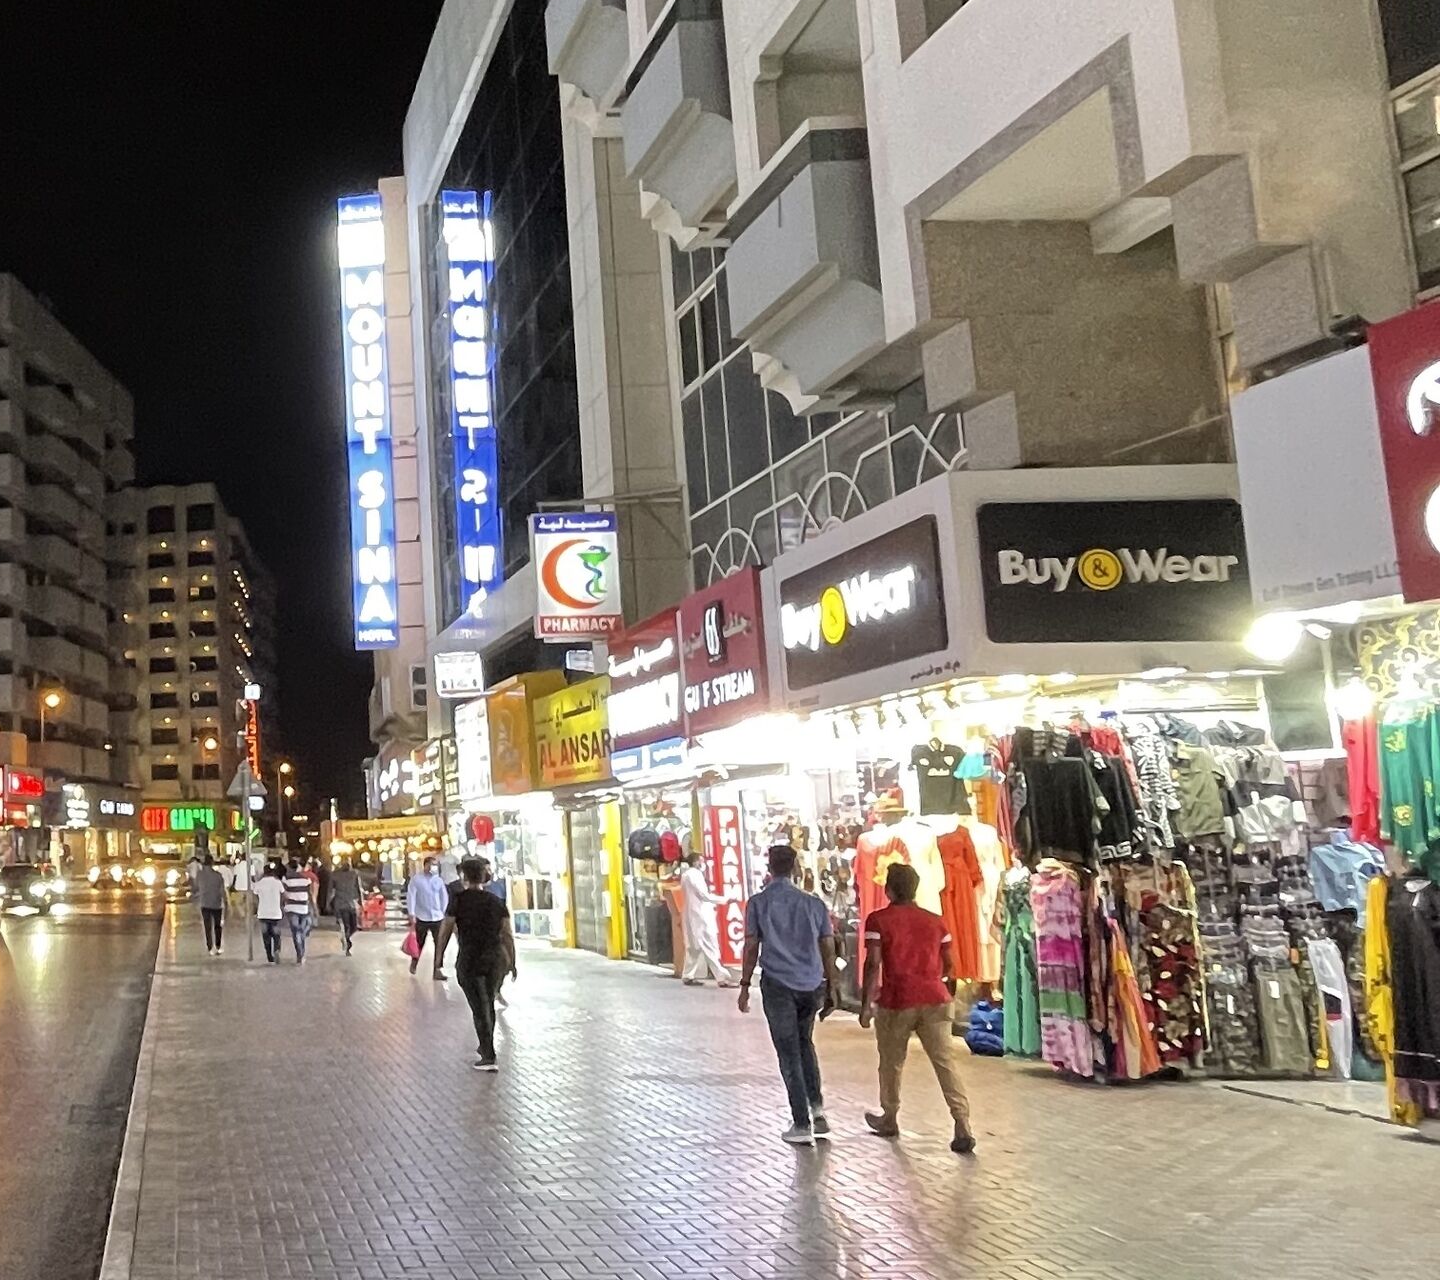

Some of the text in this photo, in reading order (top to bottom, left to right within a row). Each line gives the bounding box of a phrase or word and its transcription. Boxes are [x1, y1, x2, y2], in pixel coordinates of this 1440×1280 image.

[344, 270, 386, 454] MOUNT
[357, 470, 396, 623] SINA
[538, 517, 610, 532] صيدلية
[997, 549, 1079, 593] Buy
[1115, 547, 1239, 584] Wear
[839, 564, 916, 627] Wear
[543, 617, 616, 632] PHARMACY
[684, 680, 710, 714] GUF
[713, 668, 755, 706] STREAM
[540, 742, 557, 769] AL
[717, 808, 746, 960] PHARMACY
